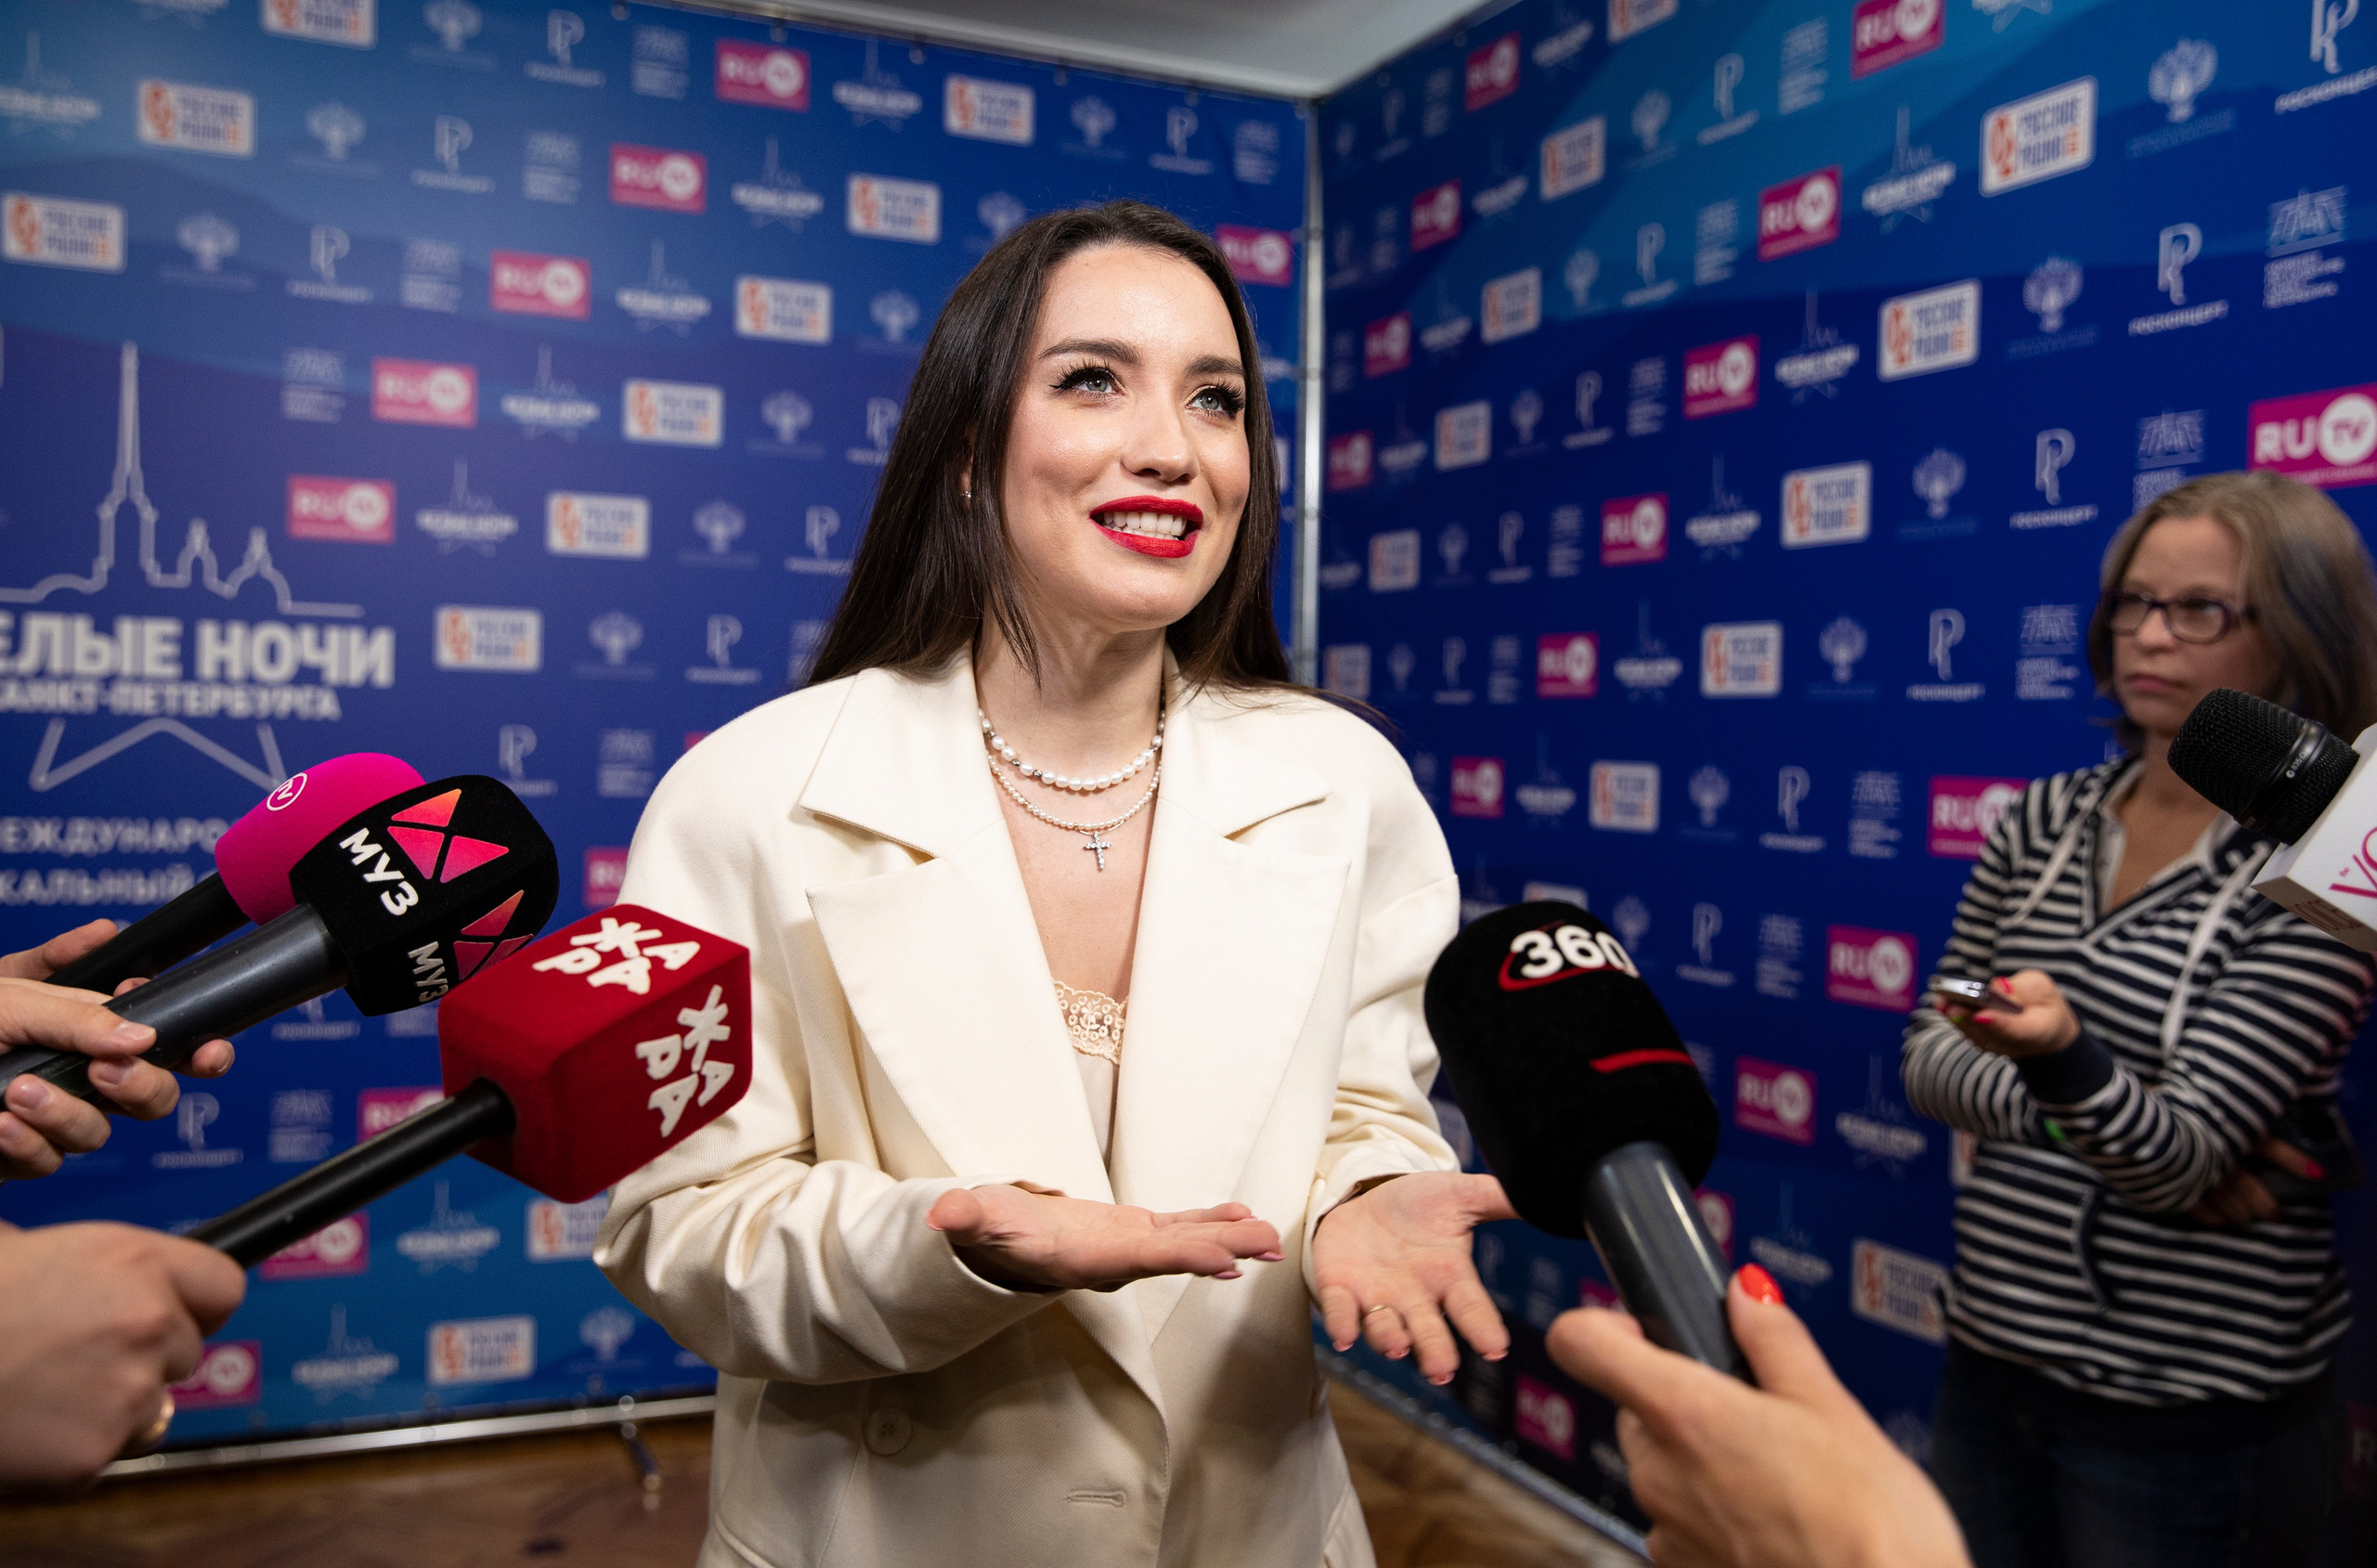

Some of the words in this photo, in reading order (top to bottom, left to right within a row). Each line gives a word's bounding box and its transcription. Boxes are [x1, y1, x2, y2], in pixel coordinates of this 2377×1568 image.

[2254, 415, 2319, 465] RU
[194, 617, 396, 690] НОЧИ
[0, 817, 234, 856] ЕЖДУНАРО
[339, 827, 419, 916] МУЗ
[407, 940, 449, 1003] МУЗ
[1510, 925, 1641, 979] 360
